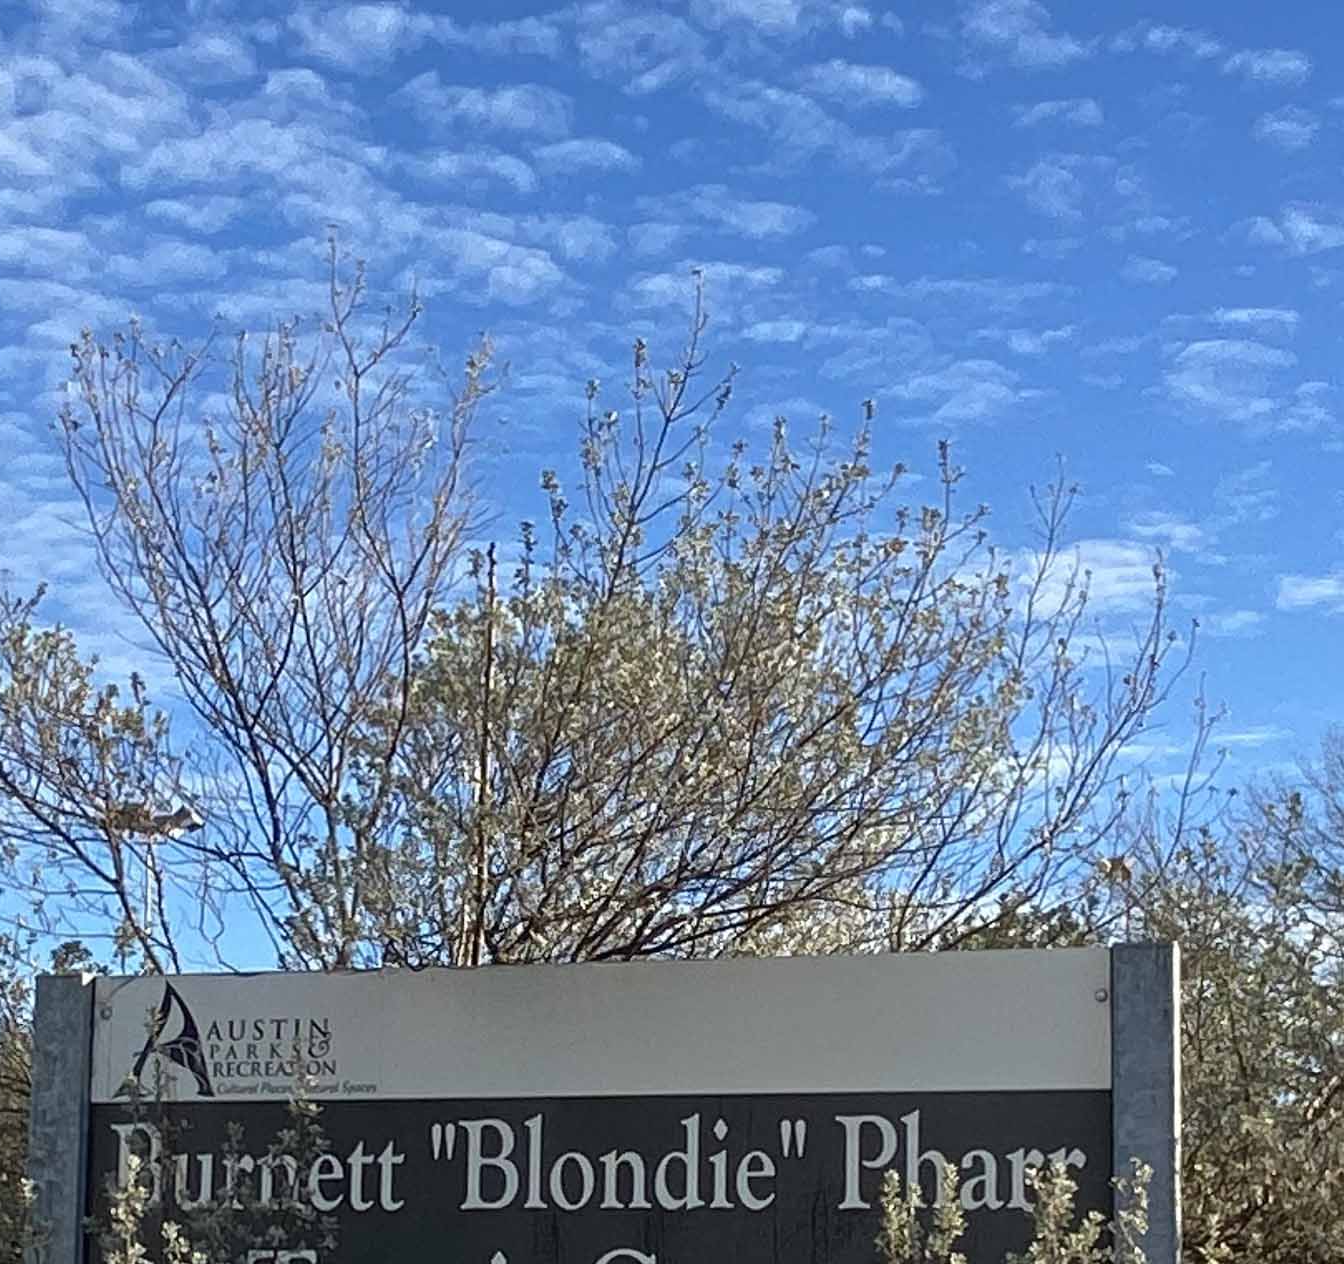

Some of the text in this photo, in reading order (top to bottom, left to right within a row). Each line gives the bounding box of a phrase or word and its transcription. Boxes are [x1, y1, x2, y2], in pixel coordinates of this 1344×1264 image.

[207, 1017, 330, 1041] AUSTIN
[209, 1042, 303, 1060] PARKS
[213, 1060, 337, 1077] RECREATON
[431, 1112, 808, 1211] "Blondie"
